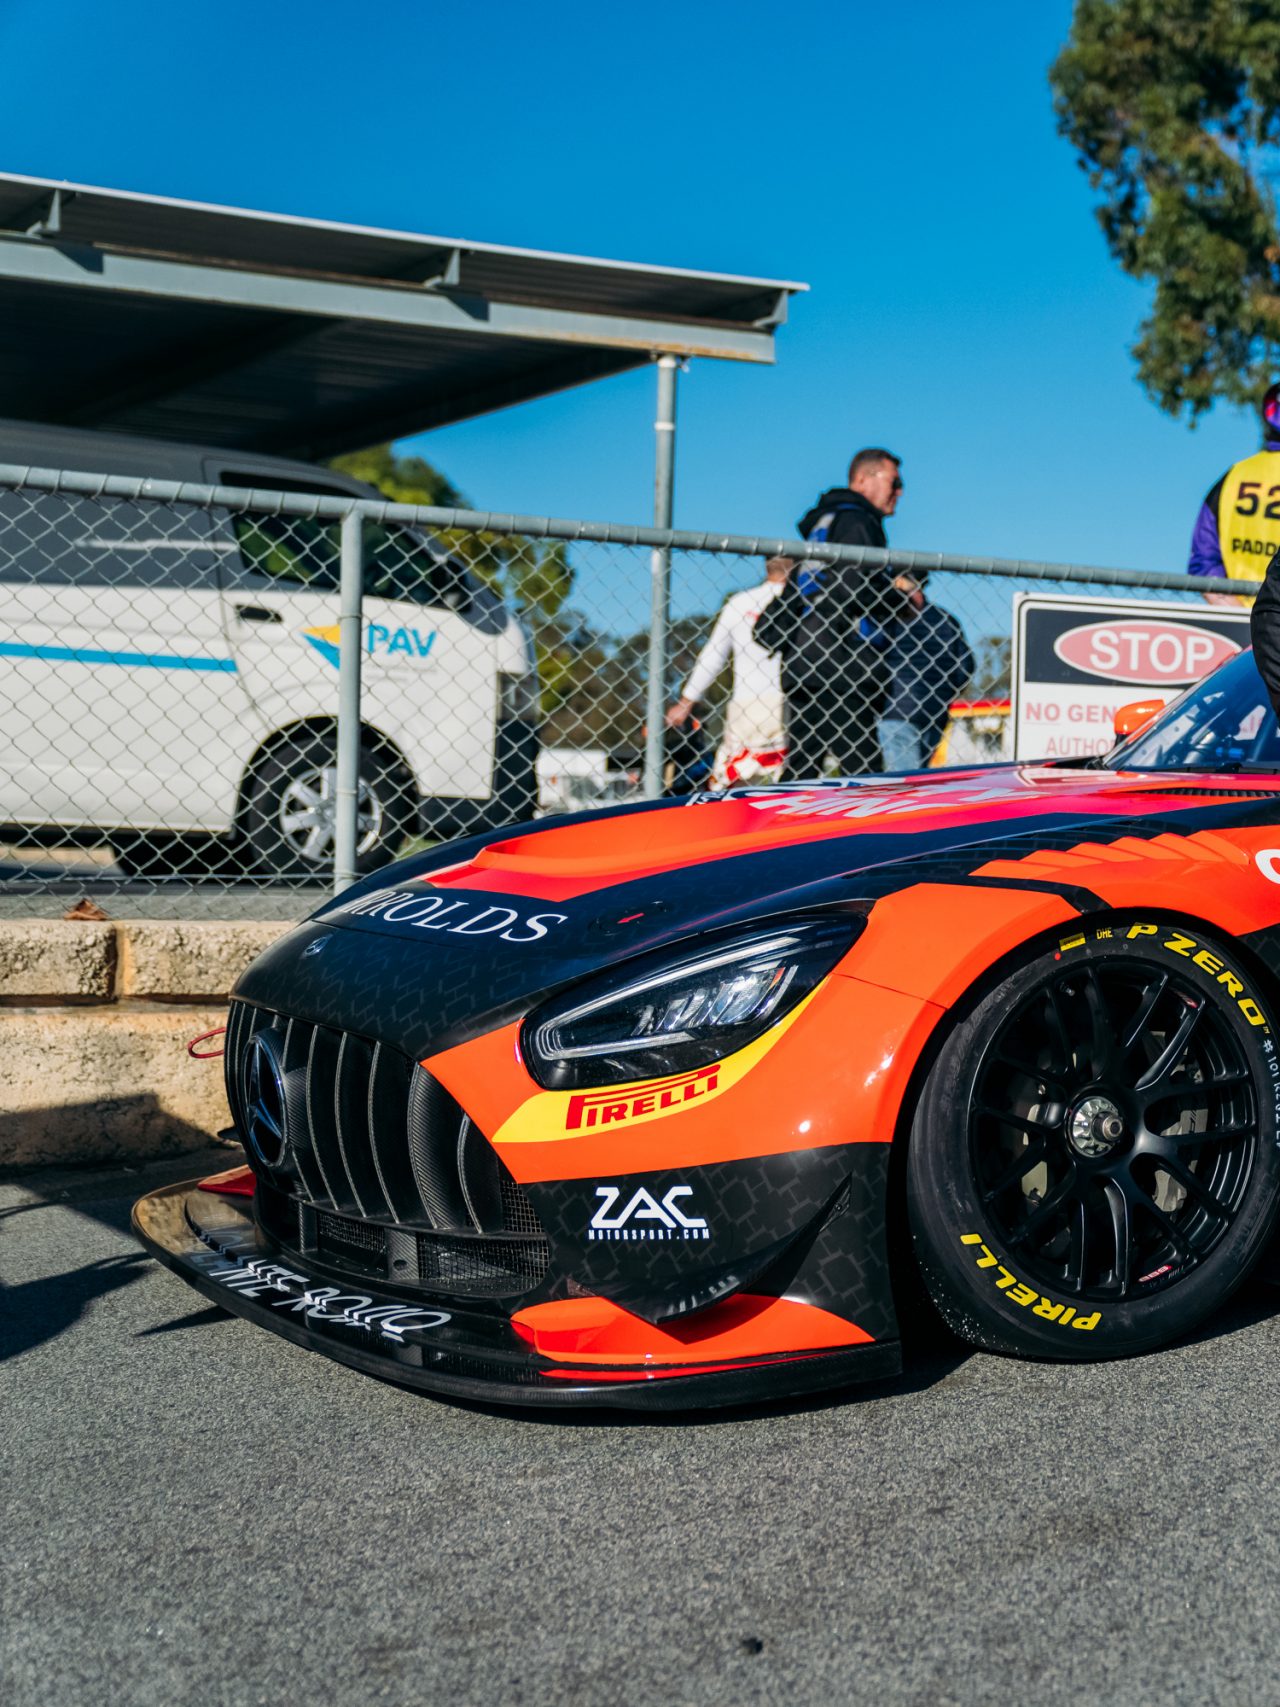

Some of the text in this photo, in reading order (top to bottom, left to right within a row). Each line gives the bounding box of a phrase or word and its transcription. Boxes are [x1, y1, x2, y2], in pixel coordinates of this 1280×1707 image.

[368, 624, 437, 657] PAV
[1090, 629, 1214, 674] STOP
[1026, 702, 1060, 721] NO
[1126, 924, 1158, 939] P
[566, 1064, 721, 1130] PIRELLI
[591, 1186, 707, 1228] ZAC
[588, 1229, 710, 1240] MOTORSPORT.COM
[960, 1233, 1102, 1330] PIRELLI
